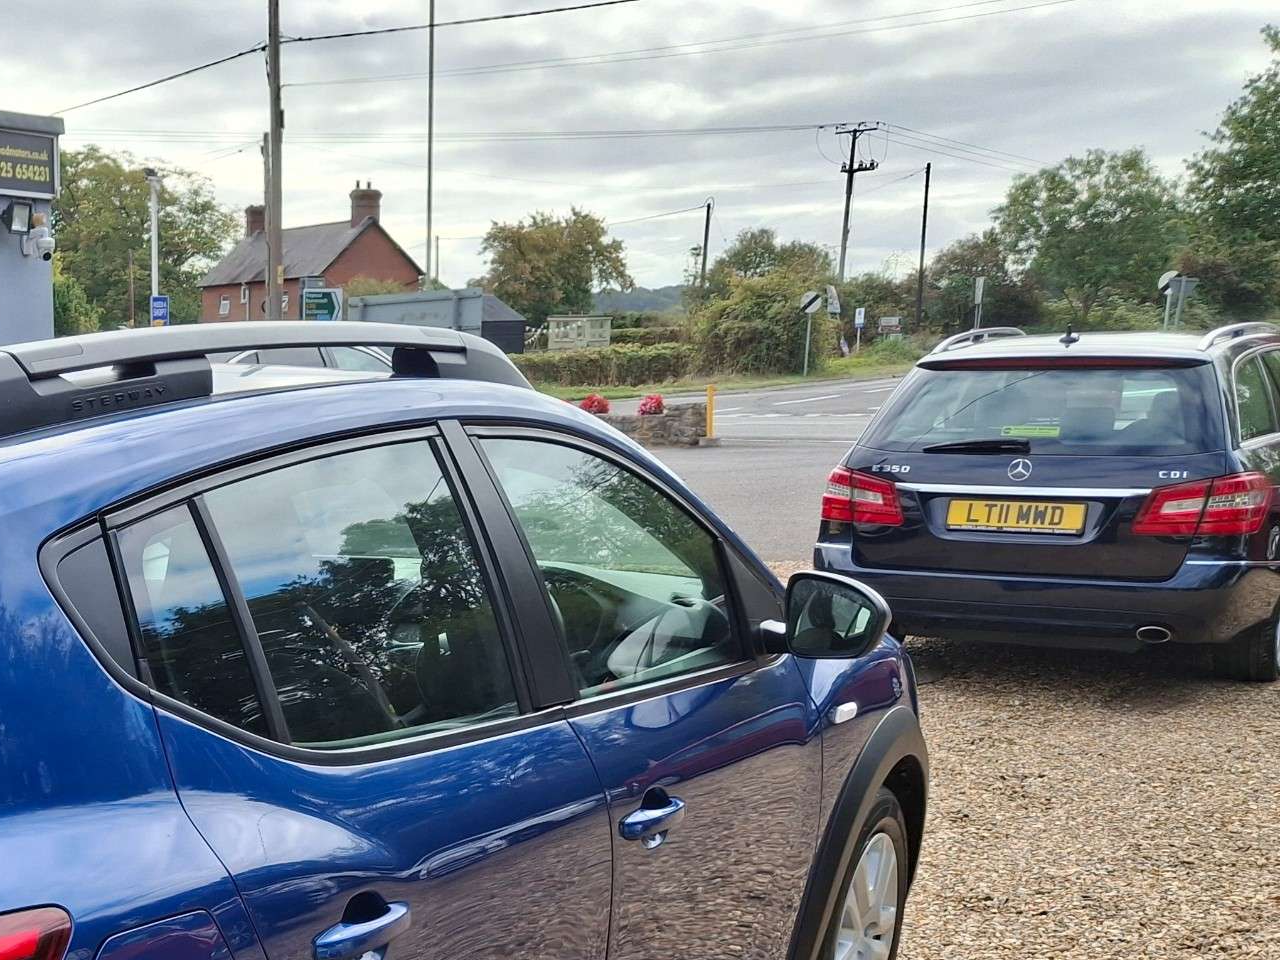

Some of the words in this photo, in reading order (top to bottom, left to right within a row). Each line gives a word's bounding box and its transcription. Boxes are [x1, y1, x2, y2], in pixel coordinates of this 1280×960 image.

[15, 163, 50, 182] 654231
[71, 384, 167, 412] STEPWAY
[1158, 470, 1188, 479] CDI
[966, 502, 1011, 524] LT11
[1016, 504, 1065, 526] MWD
